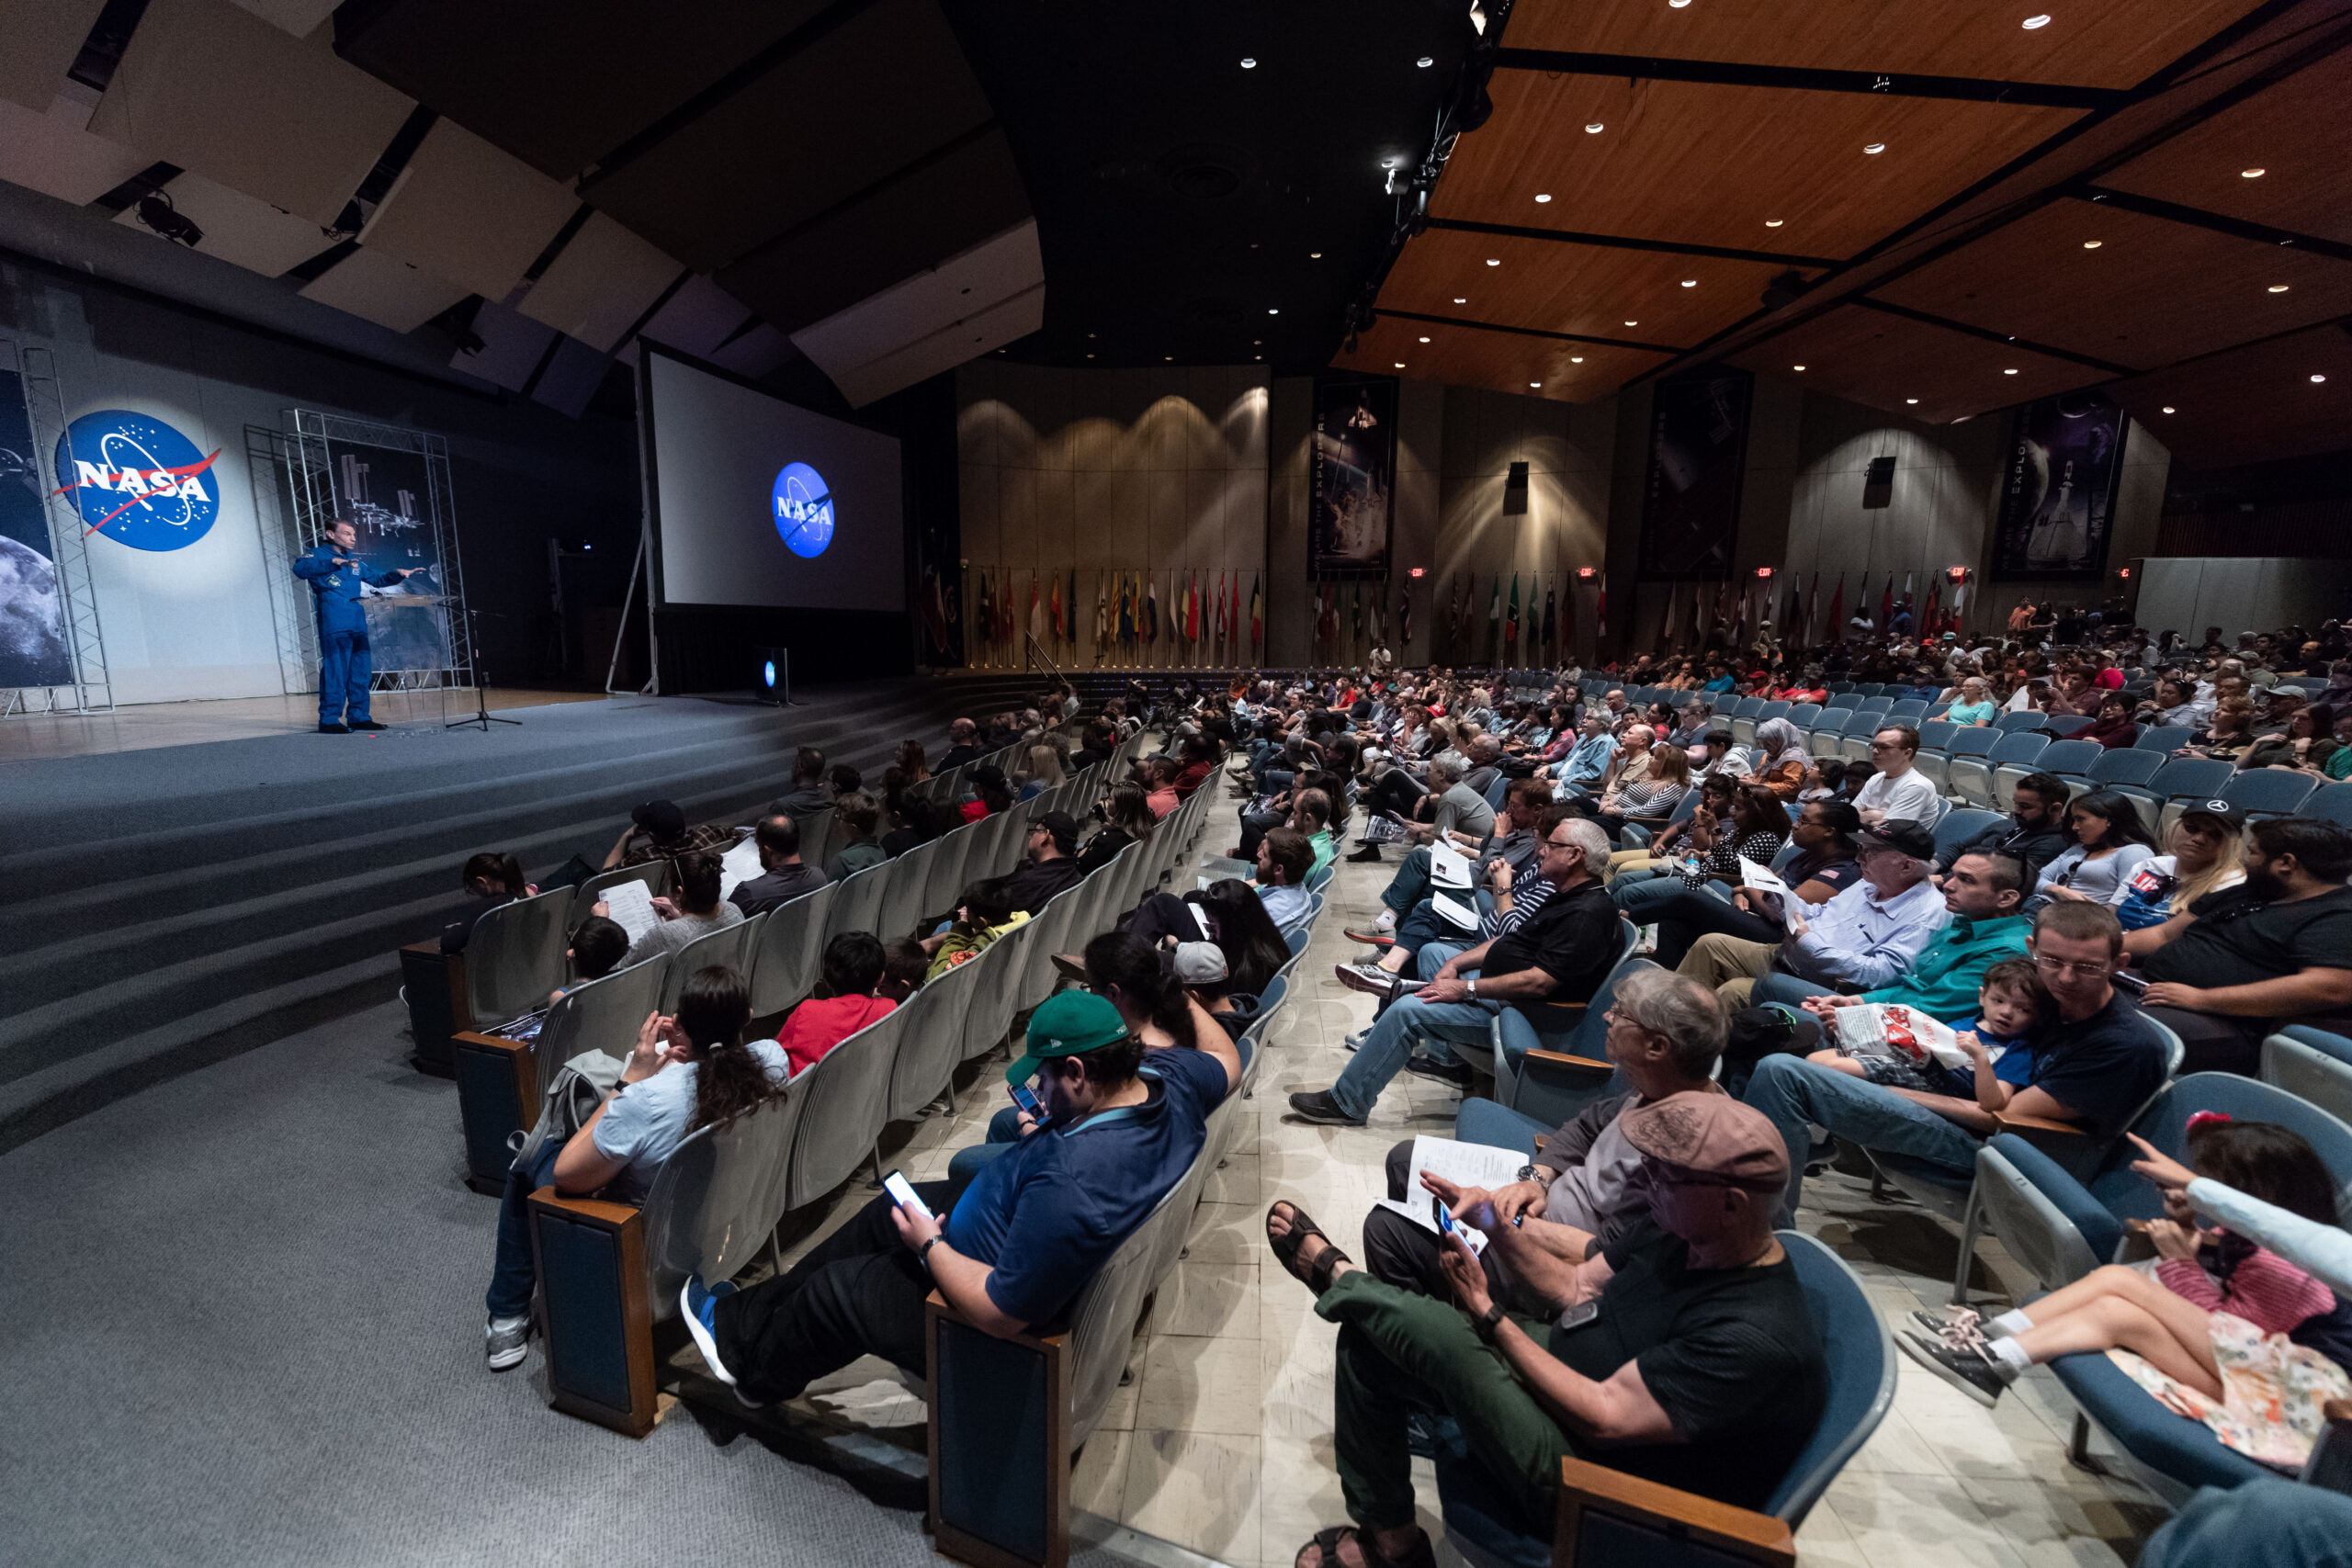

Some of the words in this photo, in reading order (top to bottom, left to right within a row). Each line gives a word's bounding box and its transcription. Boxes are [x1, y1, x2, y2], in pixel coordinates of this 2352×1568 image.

[73, 459, 212, 502] NASA
[777, 496, 832, 526] NASA
[1315, 502, 1323, 523] THE
[1412, 568, 1422, 577] EXIT
[1581, 568, 1591, 577] EXIT
[1758, 568, 1770, 577] EXIT
[1952, 567, 1964, 577] EXIT
